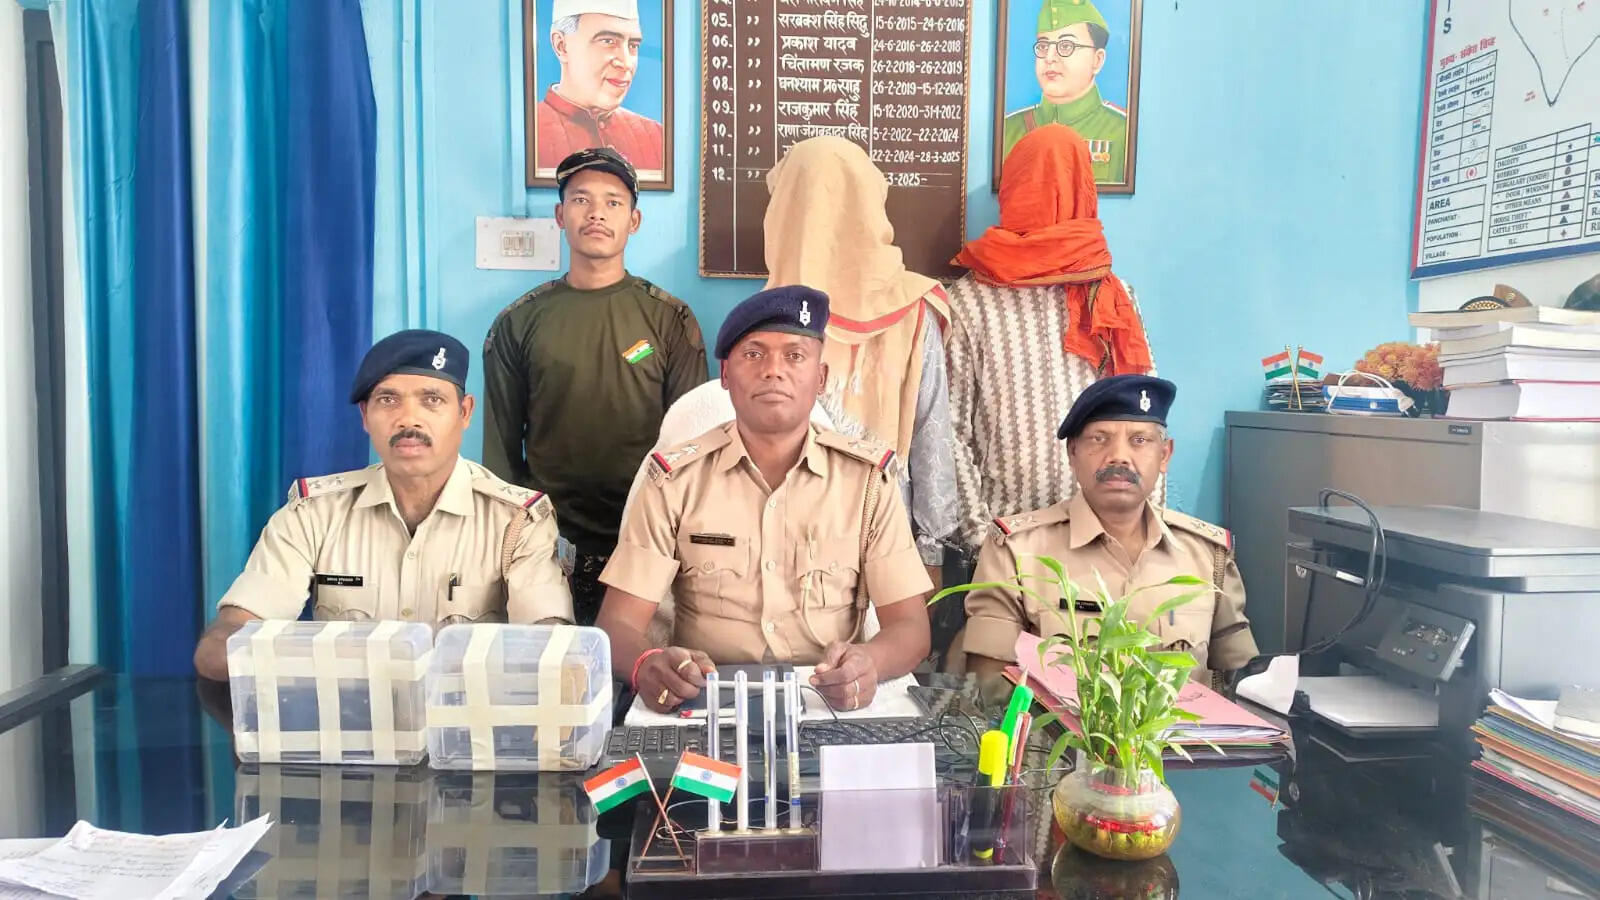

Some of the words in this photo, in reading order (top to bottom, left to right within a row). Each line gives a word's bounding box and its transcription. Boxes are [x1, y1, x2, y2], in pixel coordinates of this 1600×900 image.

[823, 10, 846, 33] सिंह
[1443, 17, 1452, 34] S
[780, 35, 820, 54] प्रकाश
[822, 36, 858, 56] यादव
[833, 58, 865, 74] रजक
[777, 77, 822, 94] घनश्याम
[777, 101, 832, 121] राजकुमार
[834, 98, 860, 123] सिंह
[1428, 197, 1451, 210] AREA
